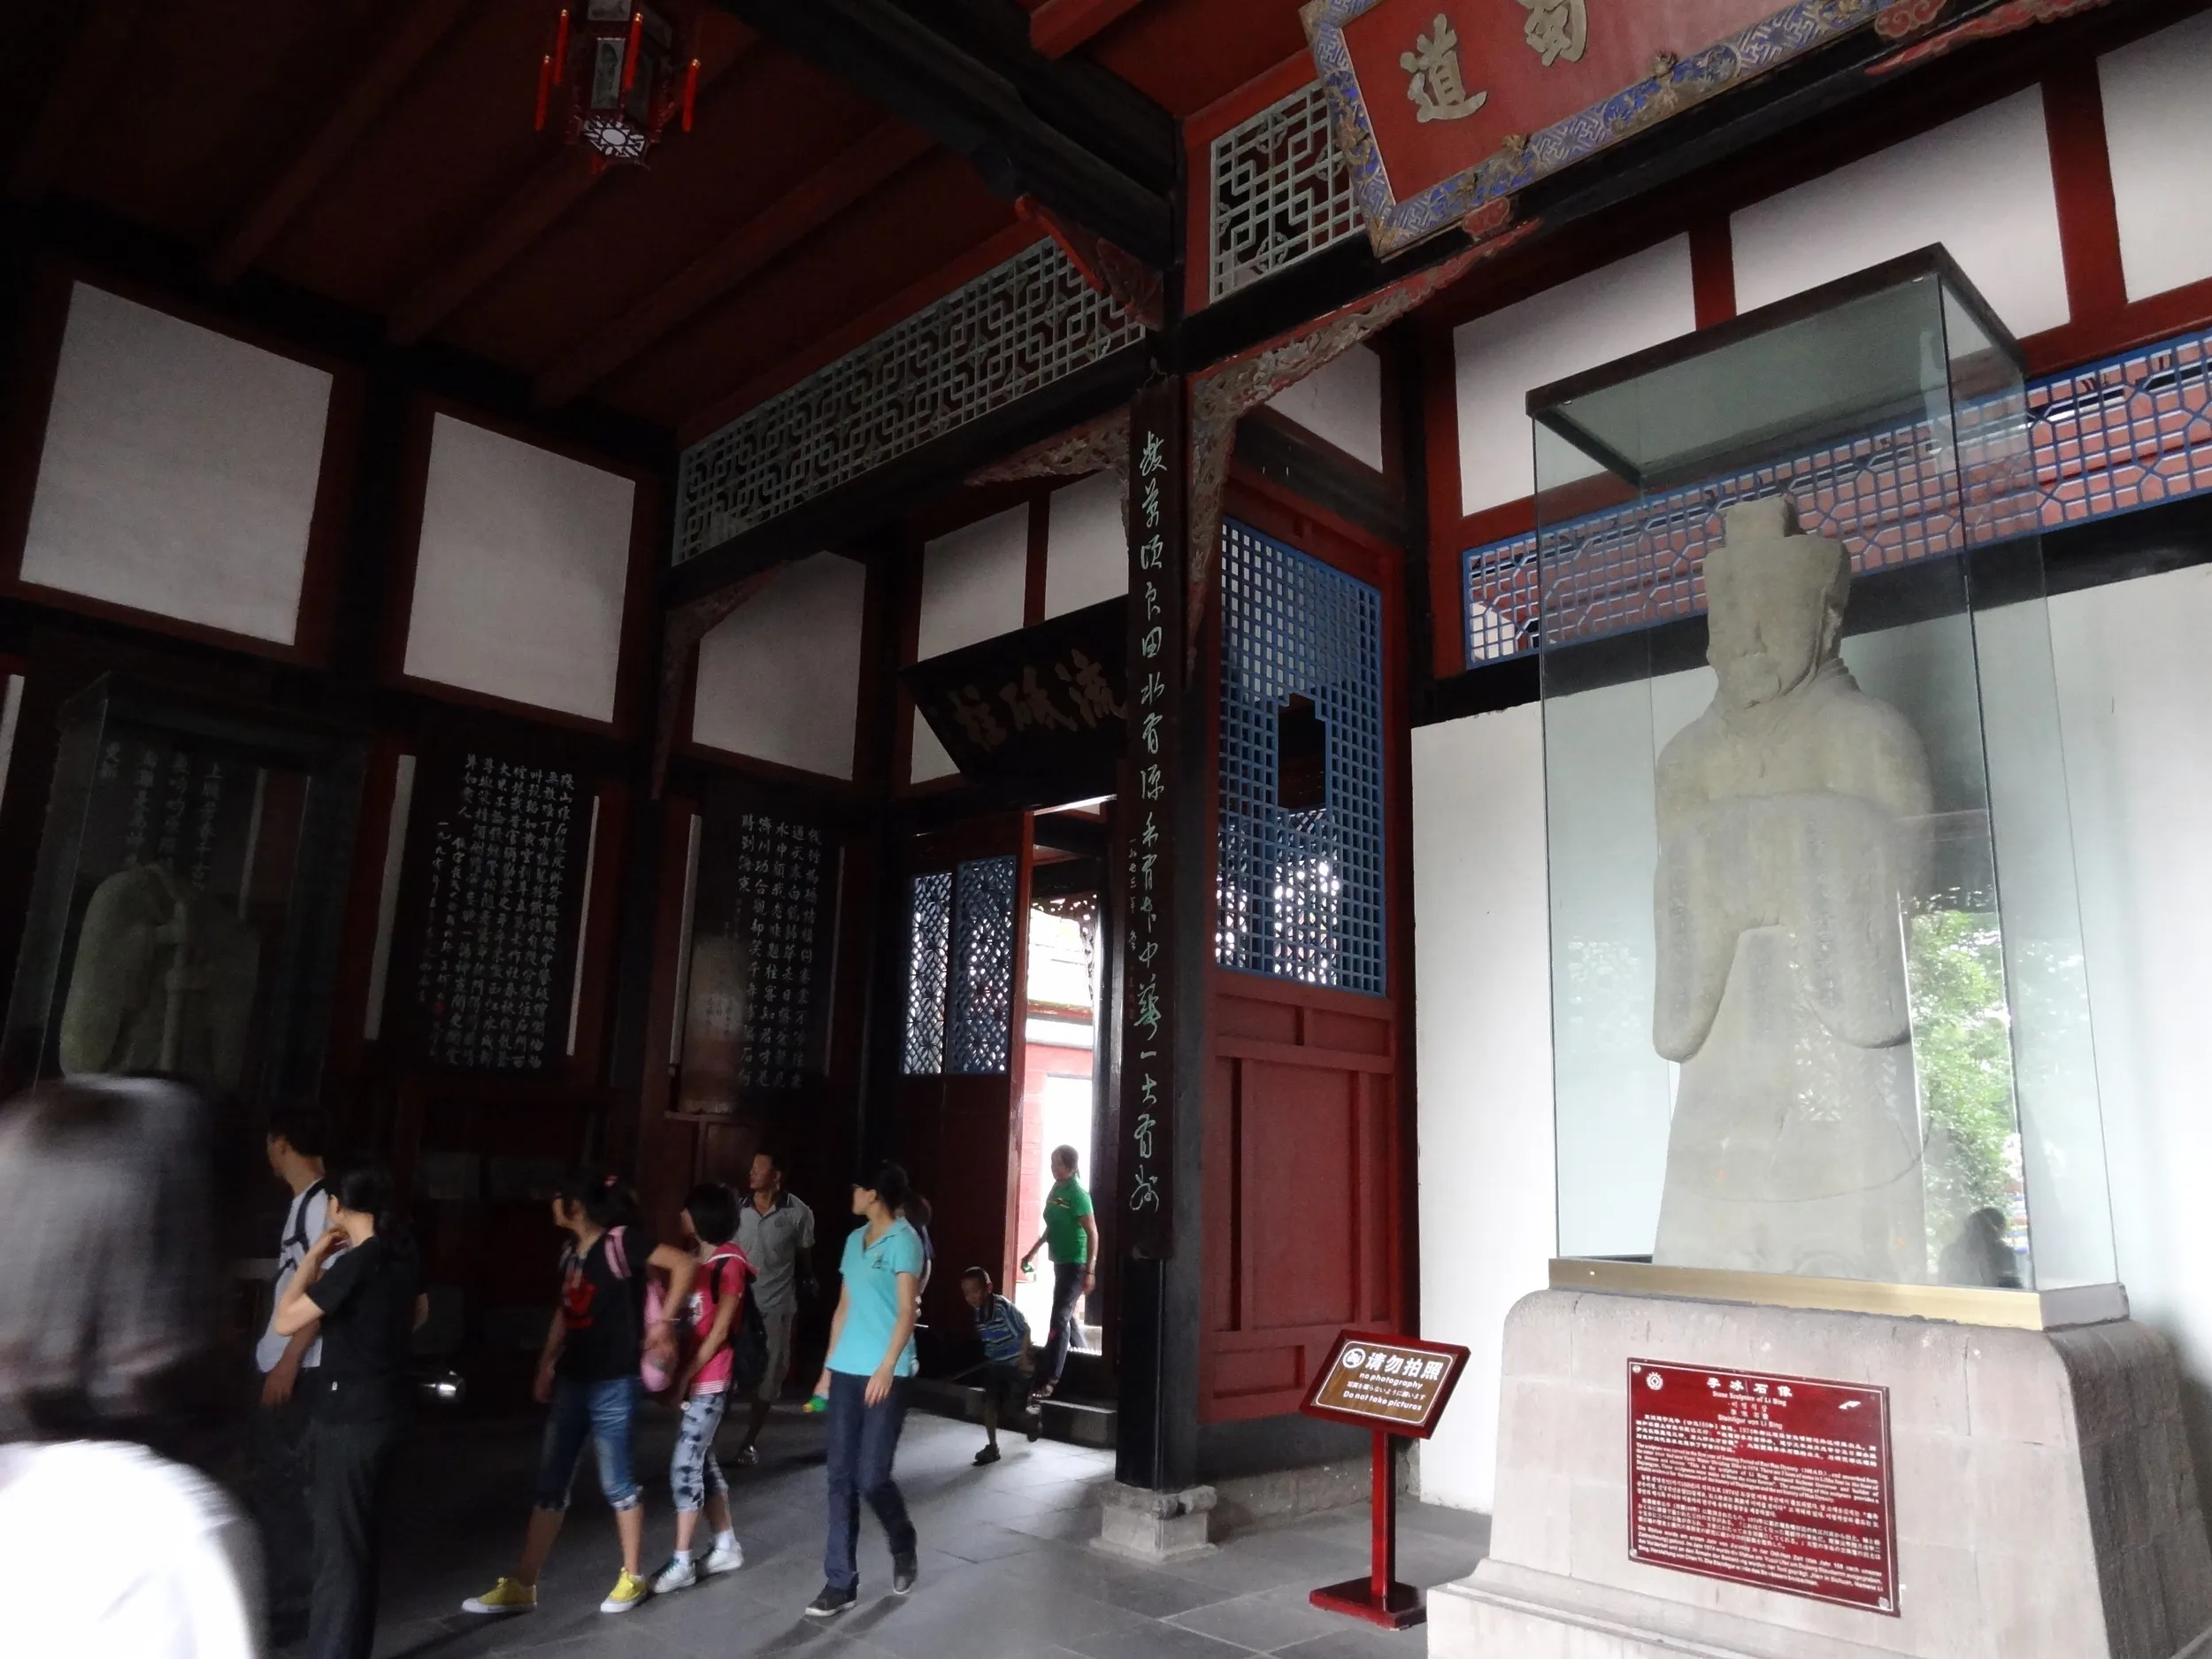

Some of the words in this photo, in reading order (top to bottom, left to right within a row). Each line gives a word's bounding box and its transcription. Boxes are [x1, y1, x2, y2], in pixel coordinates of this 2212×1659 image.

[1365, 1352, 1444, 1381] 请勿拍照
[1370, 1373, 1424, 1390] photography
[1706, 1376, 1793, 1398] 李冰石像
[1355, 1392, 1369, 1402] not
[1369, 1394, 1388, 1405] take
[1387, 1397, 1422, 1412] pictures
[1772, 1398, 1786, 1407] Bing
